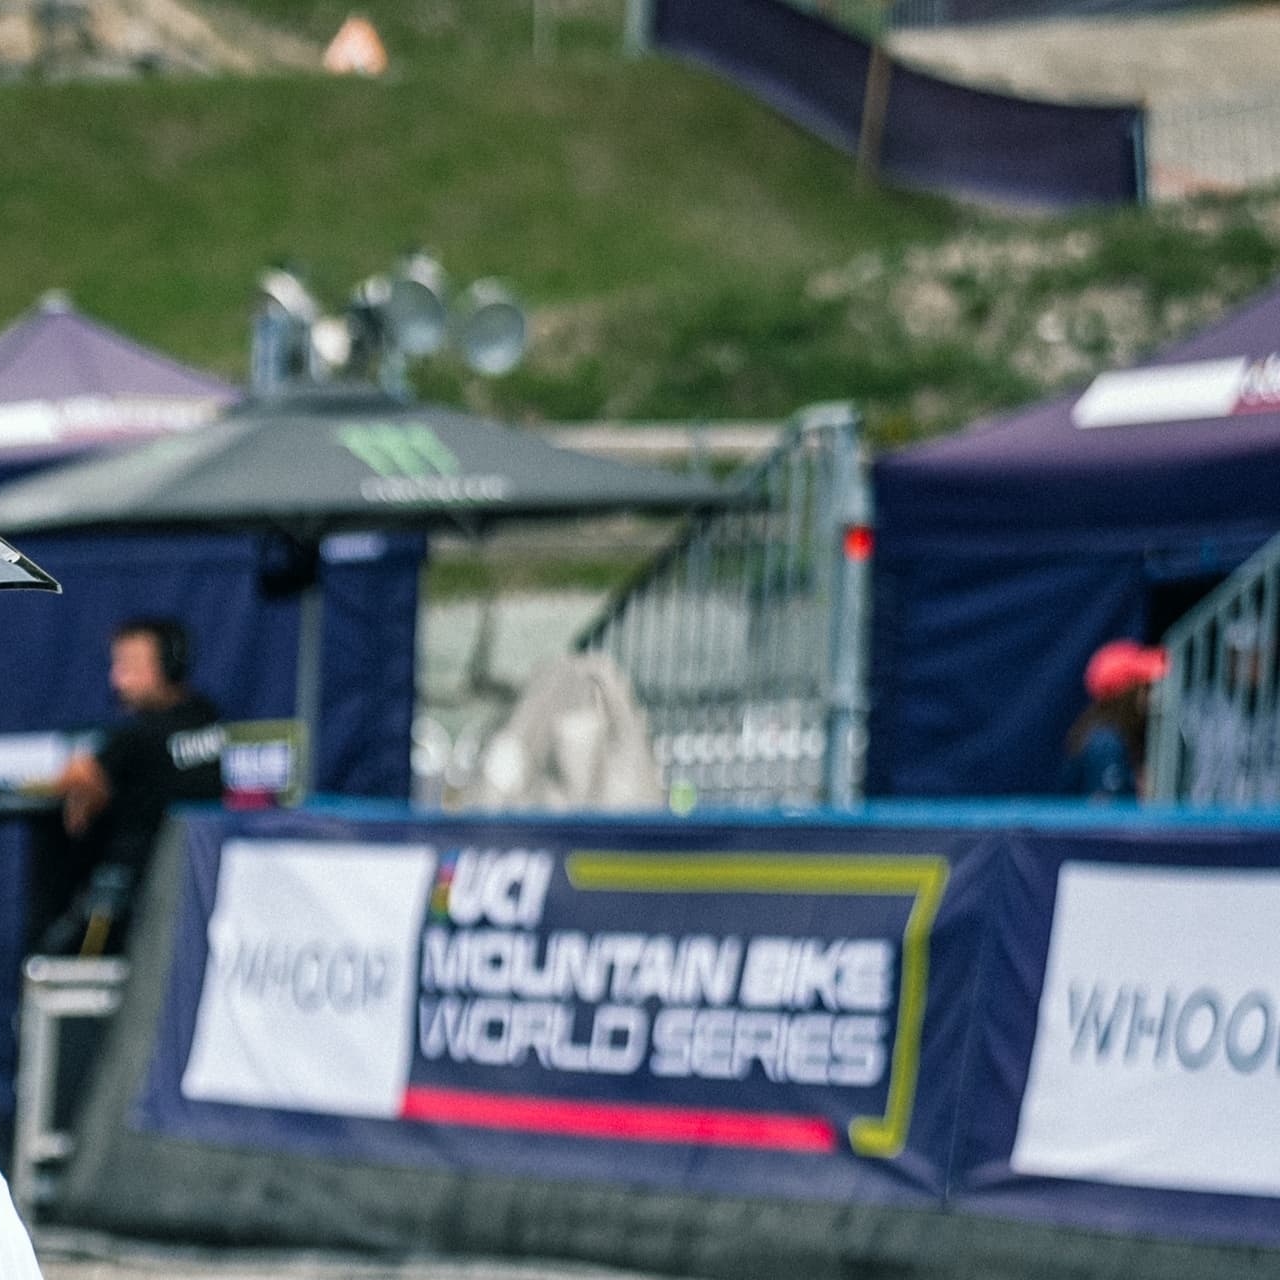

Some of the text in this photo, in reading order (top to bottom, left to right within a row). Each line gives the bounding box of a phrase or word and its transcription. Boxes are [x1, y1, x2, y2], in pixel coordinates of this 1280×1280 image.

[449, 847, 553, 926] UCI
[422, 928, 893, 1012] MOUNTAIN BIKE
[418, 998, 887, 1087] WORLD SERIES
[1068, 980, 1280, 1074] WHOO
